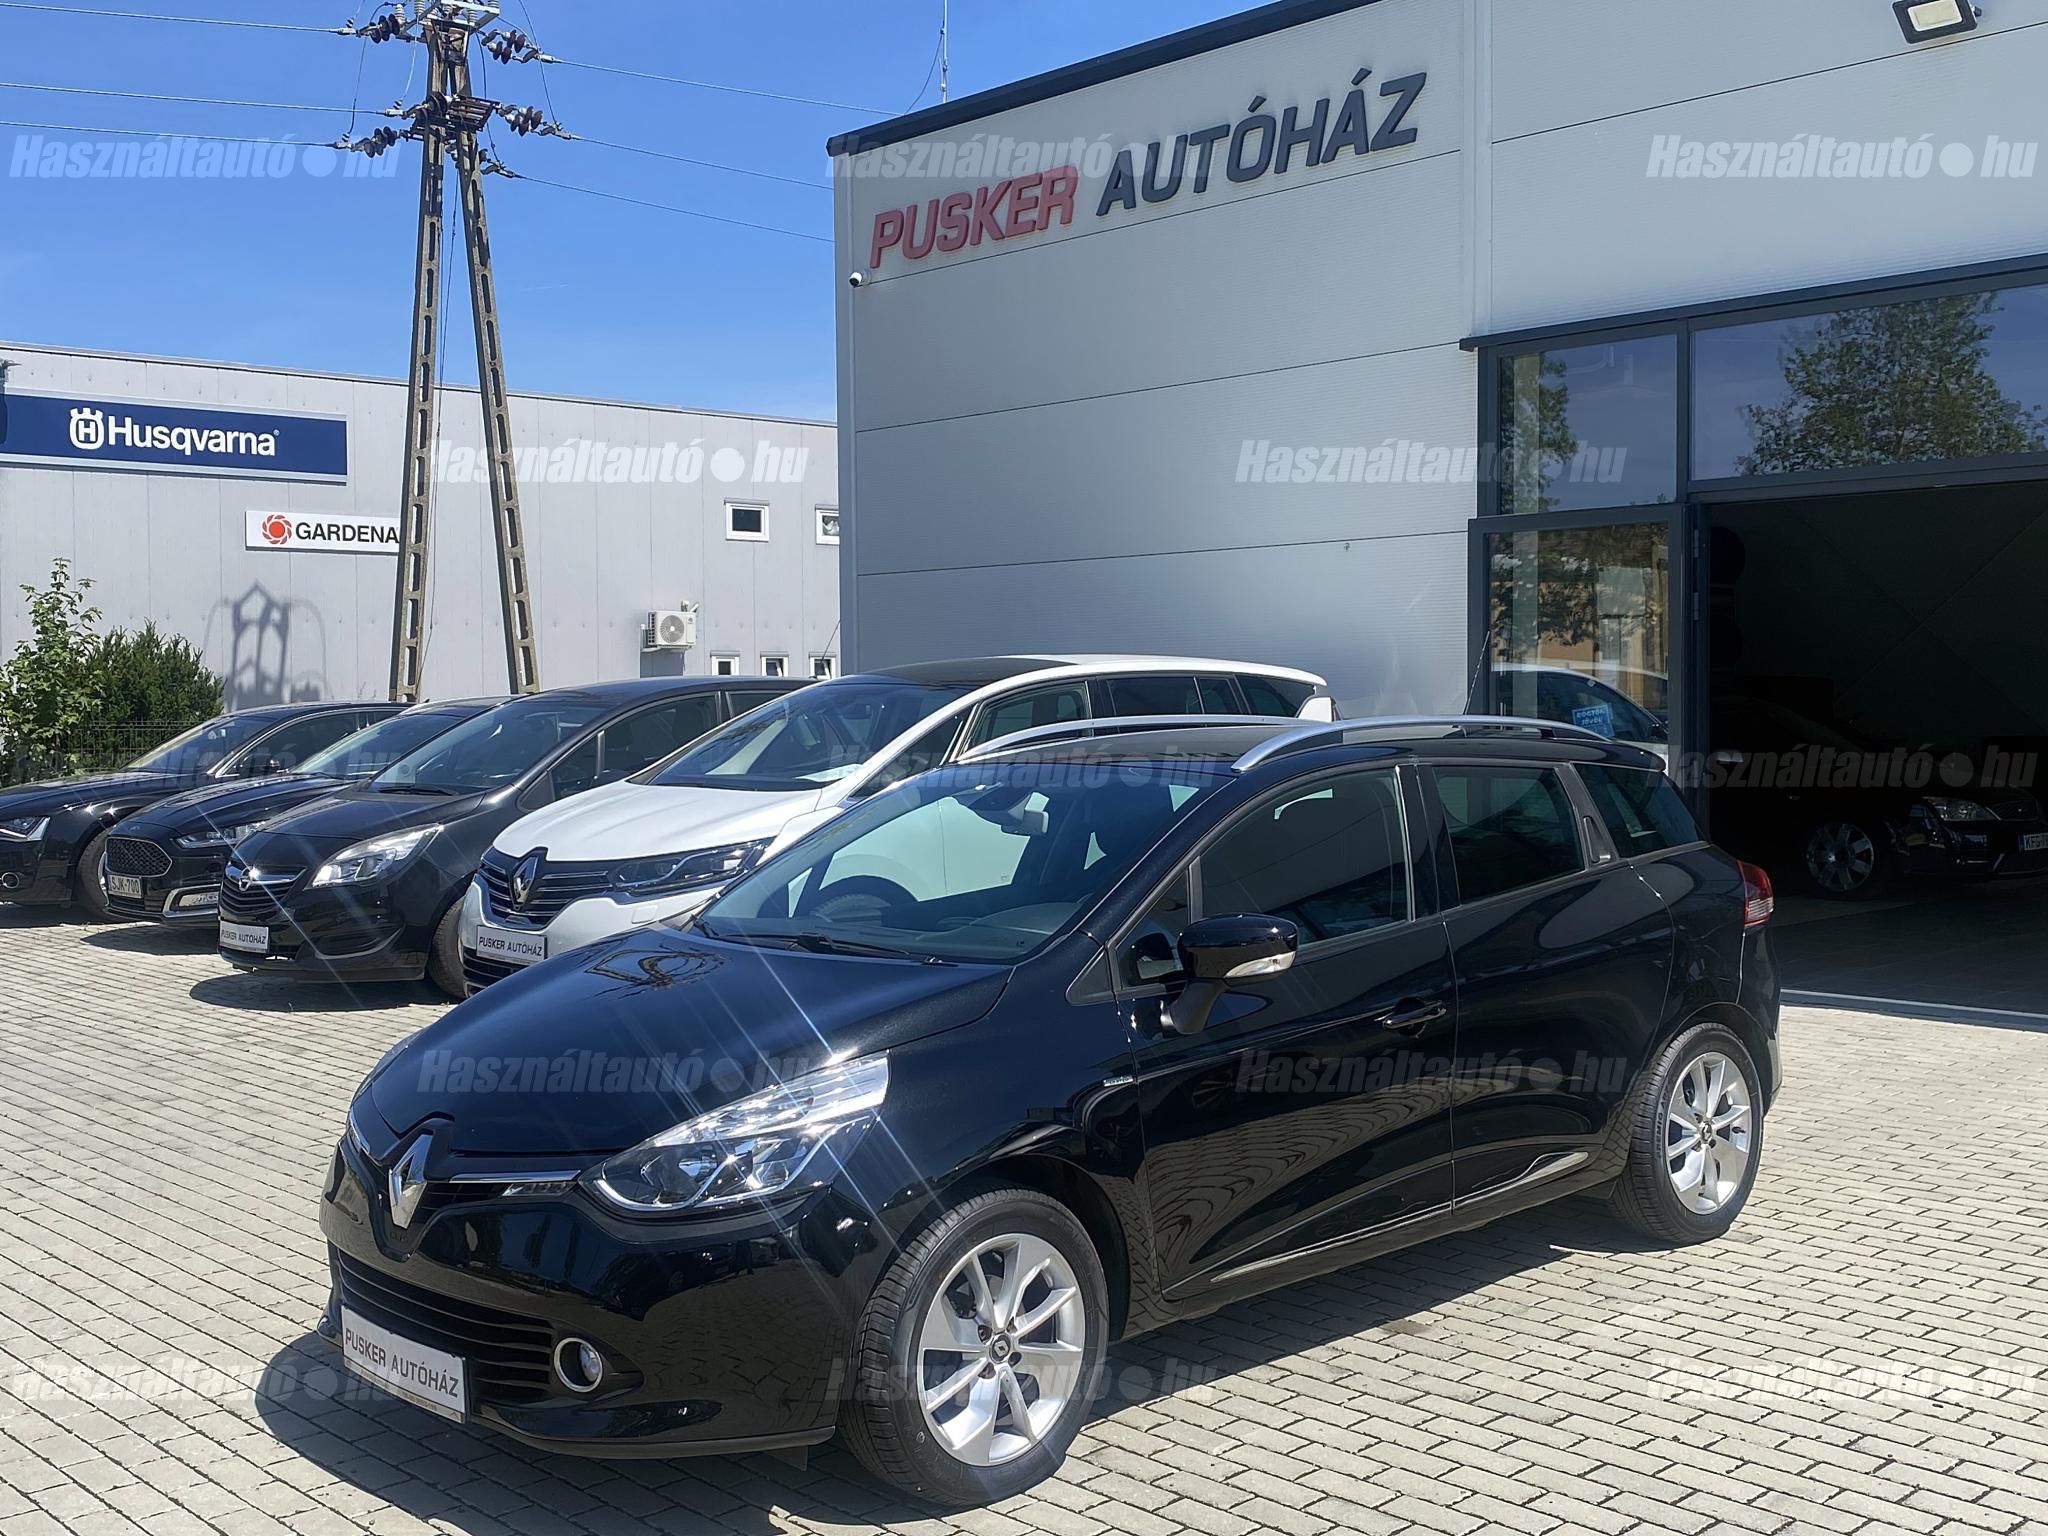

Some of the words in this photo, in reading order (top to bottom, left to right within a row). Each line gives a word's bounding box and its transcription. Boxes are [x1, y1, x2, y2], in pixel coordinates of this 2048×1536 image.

[869, 165, 1080, 269] PUSKER
[1096, 67, 1427, 216] AUTÓHÁZ
[108, 415, 276, 457] Husqvarna
[295, 521, 400, 544] GARDENA
[479, 936, 506, 950] PUSKER
[345, 1327, 386, 1367] PUSKER
[391, 1354, 459, 1398] AUTÓHÁZ
